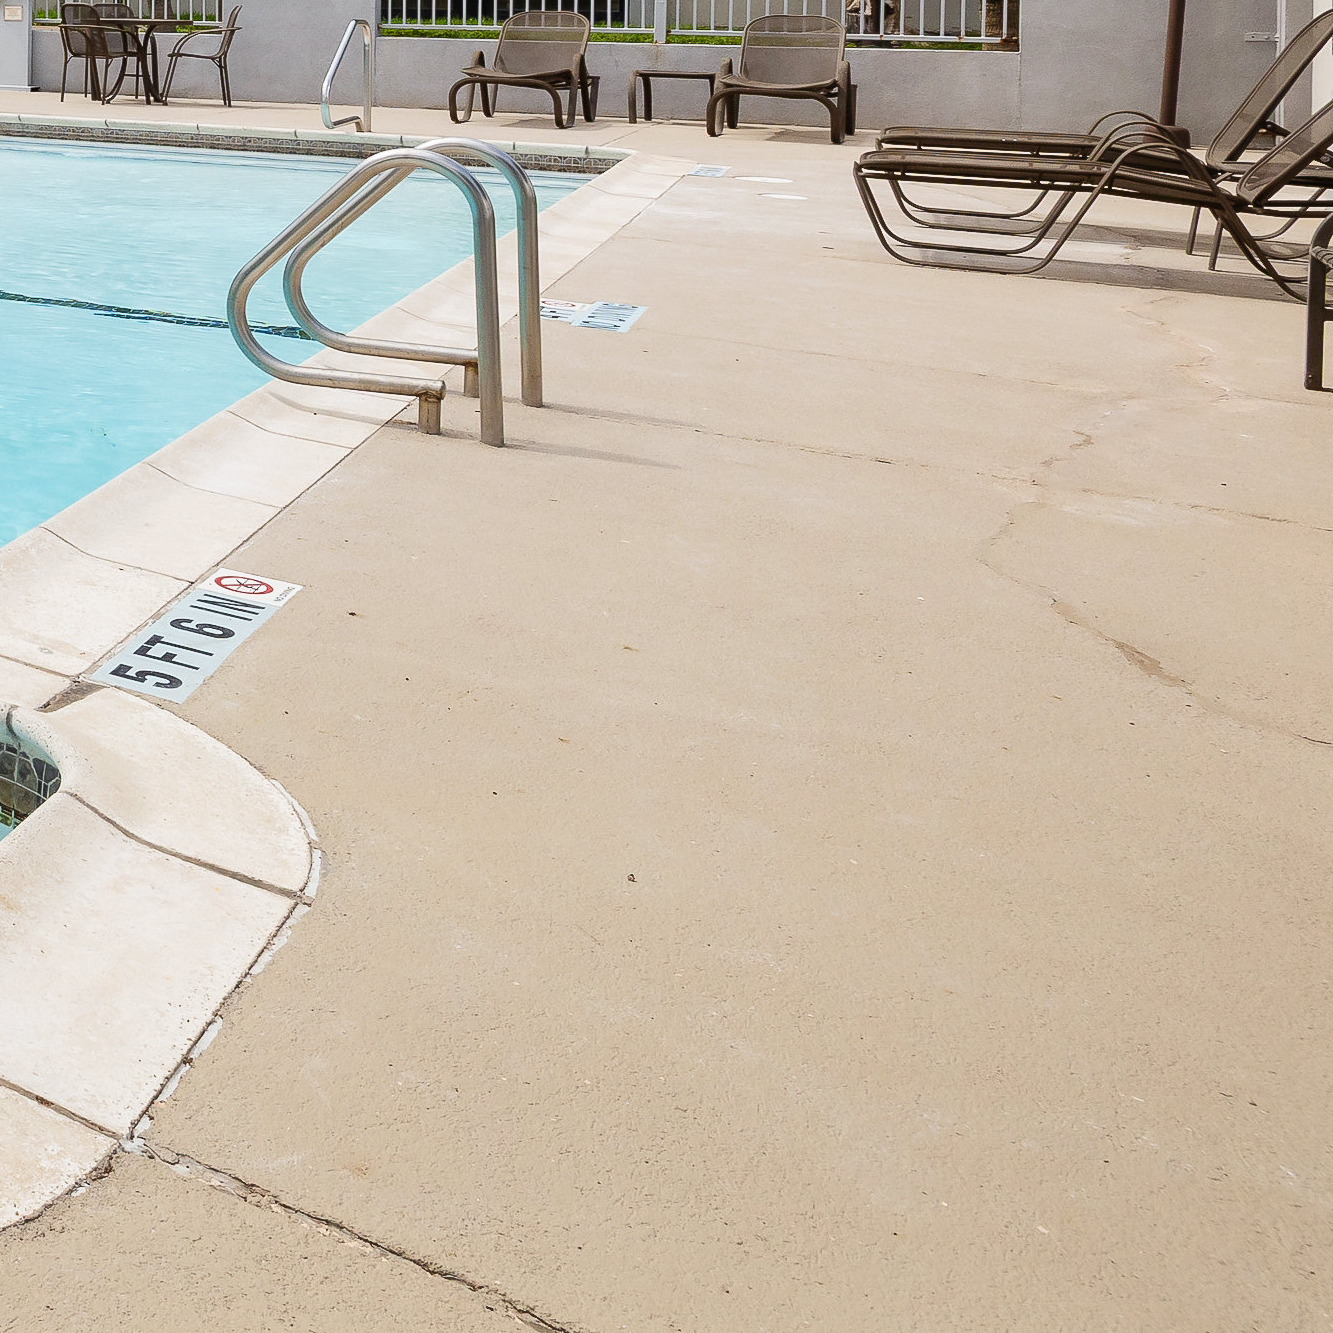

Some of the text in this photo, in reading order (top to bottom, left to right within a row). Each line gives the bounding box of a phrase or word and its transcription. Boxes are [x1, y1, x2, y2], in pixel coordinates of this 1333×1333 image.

[109, 593, 266, 689] 5 FT 6 IN
